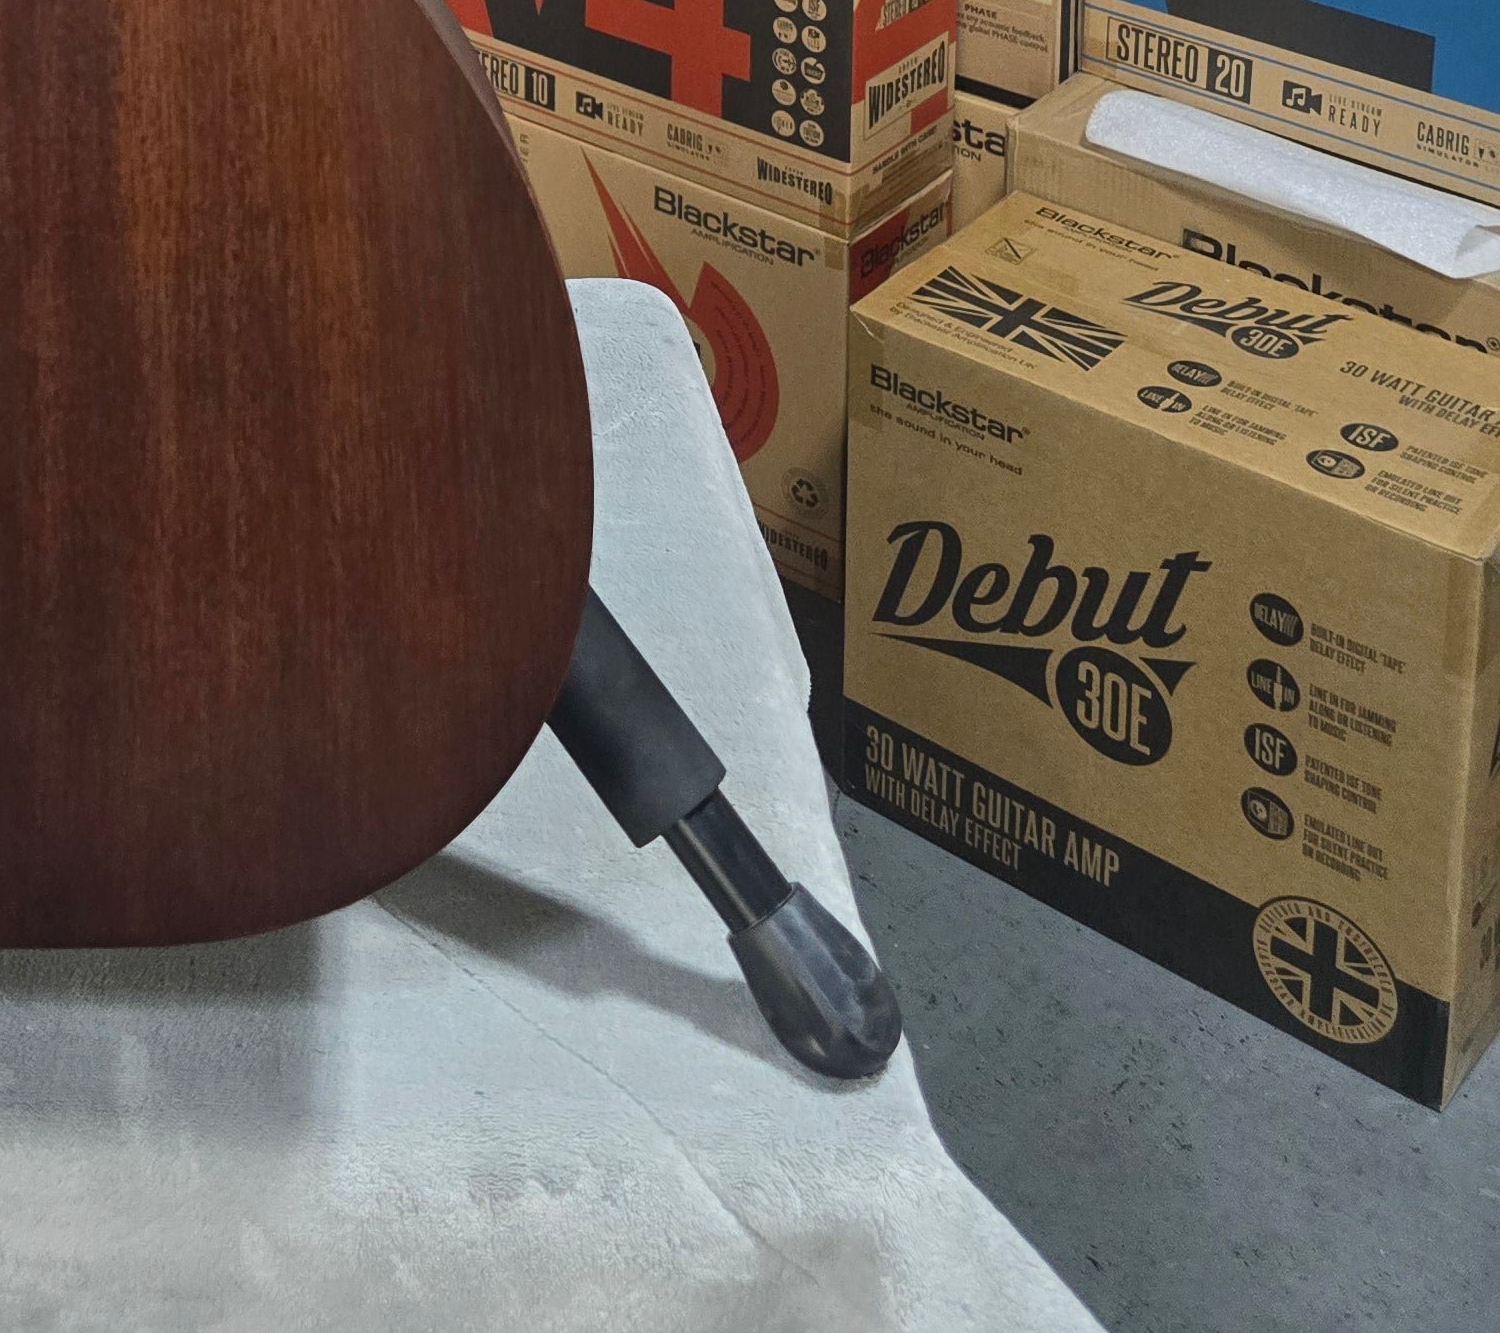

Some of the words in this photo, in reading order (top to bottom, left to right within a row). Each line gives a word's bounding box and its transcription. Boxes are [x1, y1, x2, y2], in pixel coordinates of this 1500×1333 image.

[964, 3, 998, 20] PHASE
[867, 39, 946, 131] WIDESTEREO
[1116, 22, 1200, 84] STEREO
[1214, 53, 1246, 99] 20
[531, 71, 549, 106] 10
[607, 110, 645, 137] READY
[1328, 103, 1382, 137] READY
[1416, 120, 1470, 157] CABRIG
[756, 155, 834, 206] WIDESTEREO
[653, 185, 816, 267] Blackstar
[690, 228, 775, 267] AMPLIFICATION
[859, 201, 946, 280] Blackstar
[1034, 206, 1173, 261] Blackstar
[1122, 281, 1355, 335] Debut
[1239, 328, 1293, 359] 30E
[869, 363, 1024, 444] Blackstar
[1339, 360, 1370, 379] 30
[1369, 369, 1427, 398] WATT
[1424, 388, 1497, 423] GUITAR
[1397, 394, 1436, 414] WITH
[1435, 403, 1483, 430] DELAY
[869, 403, 893, 421] the
[895, 416, 936, 440] sound
[939, 432, 953, 446] in
[955, 440, 987, 460] your
[988, 452, 1023, 476] head
[906, 402, 986, 442] AMPLIFICATION
[1346, 424, 1392, 450] ISF
[871, 518, 1213, 650] Debut
[1075, 658, 1153, 757] 30E
[1254, 726, 1288, 770] ISF
[864, 761, 906, 811] WITH
[909, 788, 961, 838] DELAY
[963, 816, 1023, 872] EFFECT
[865, 724, 895, 773] 30
[900, 742, 965, 809] WATT
[971, 781, 1056, 860] GUITAR
[1062, 829, 1121, 888] AMP
